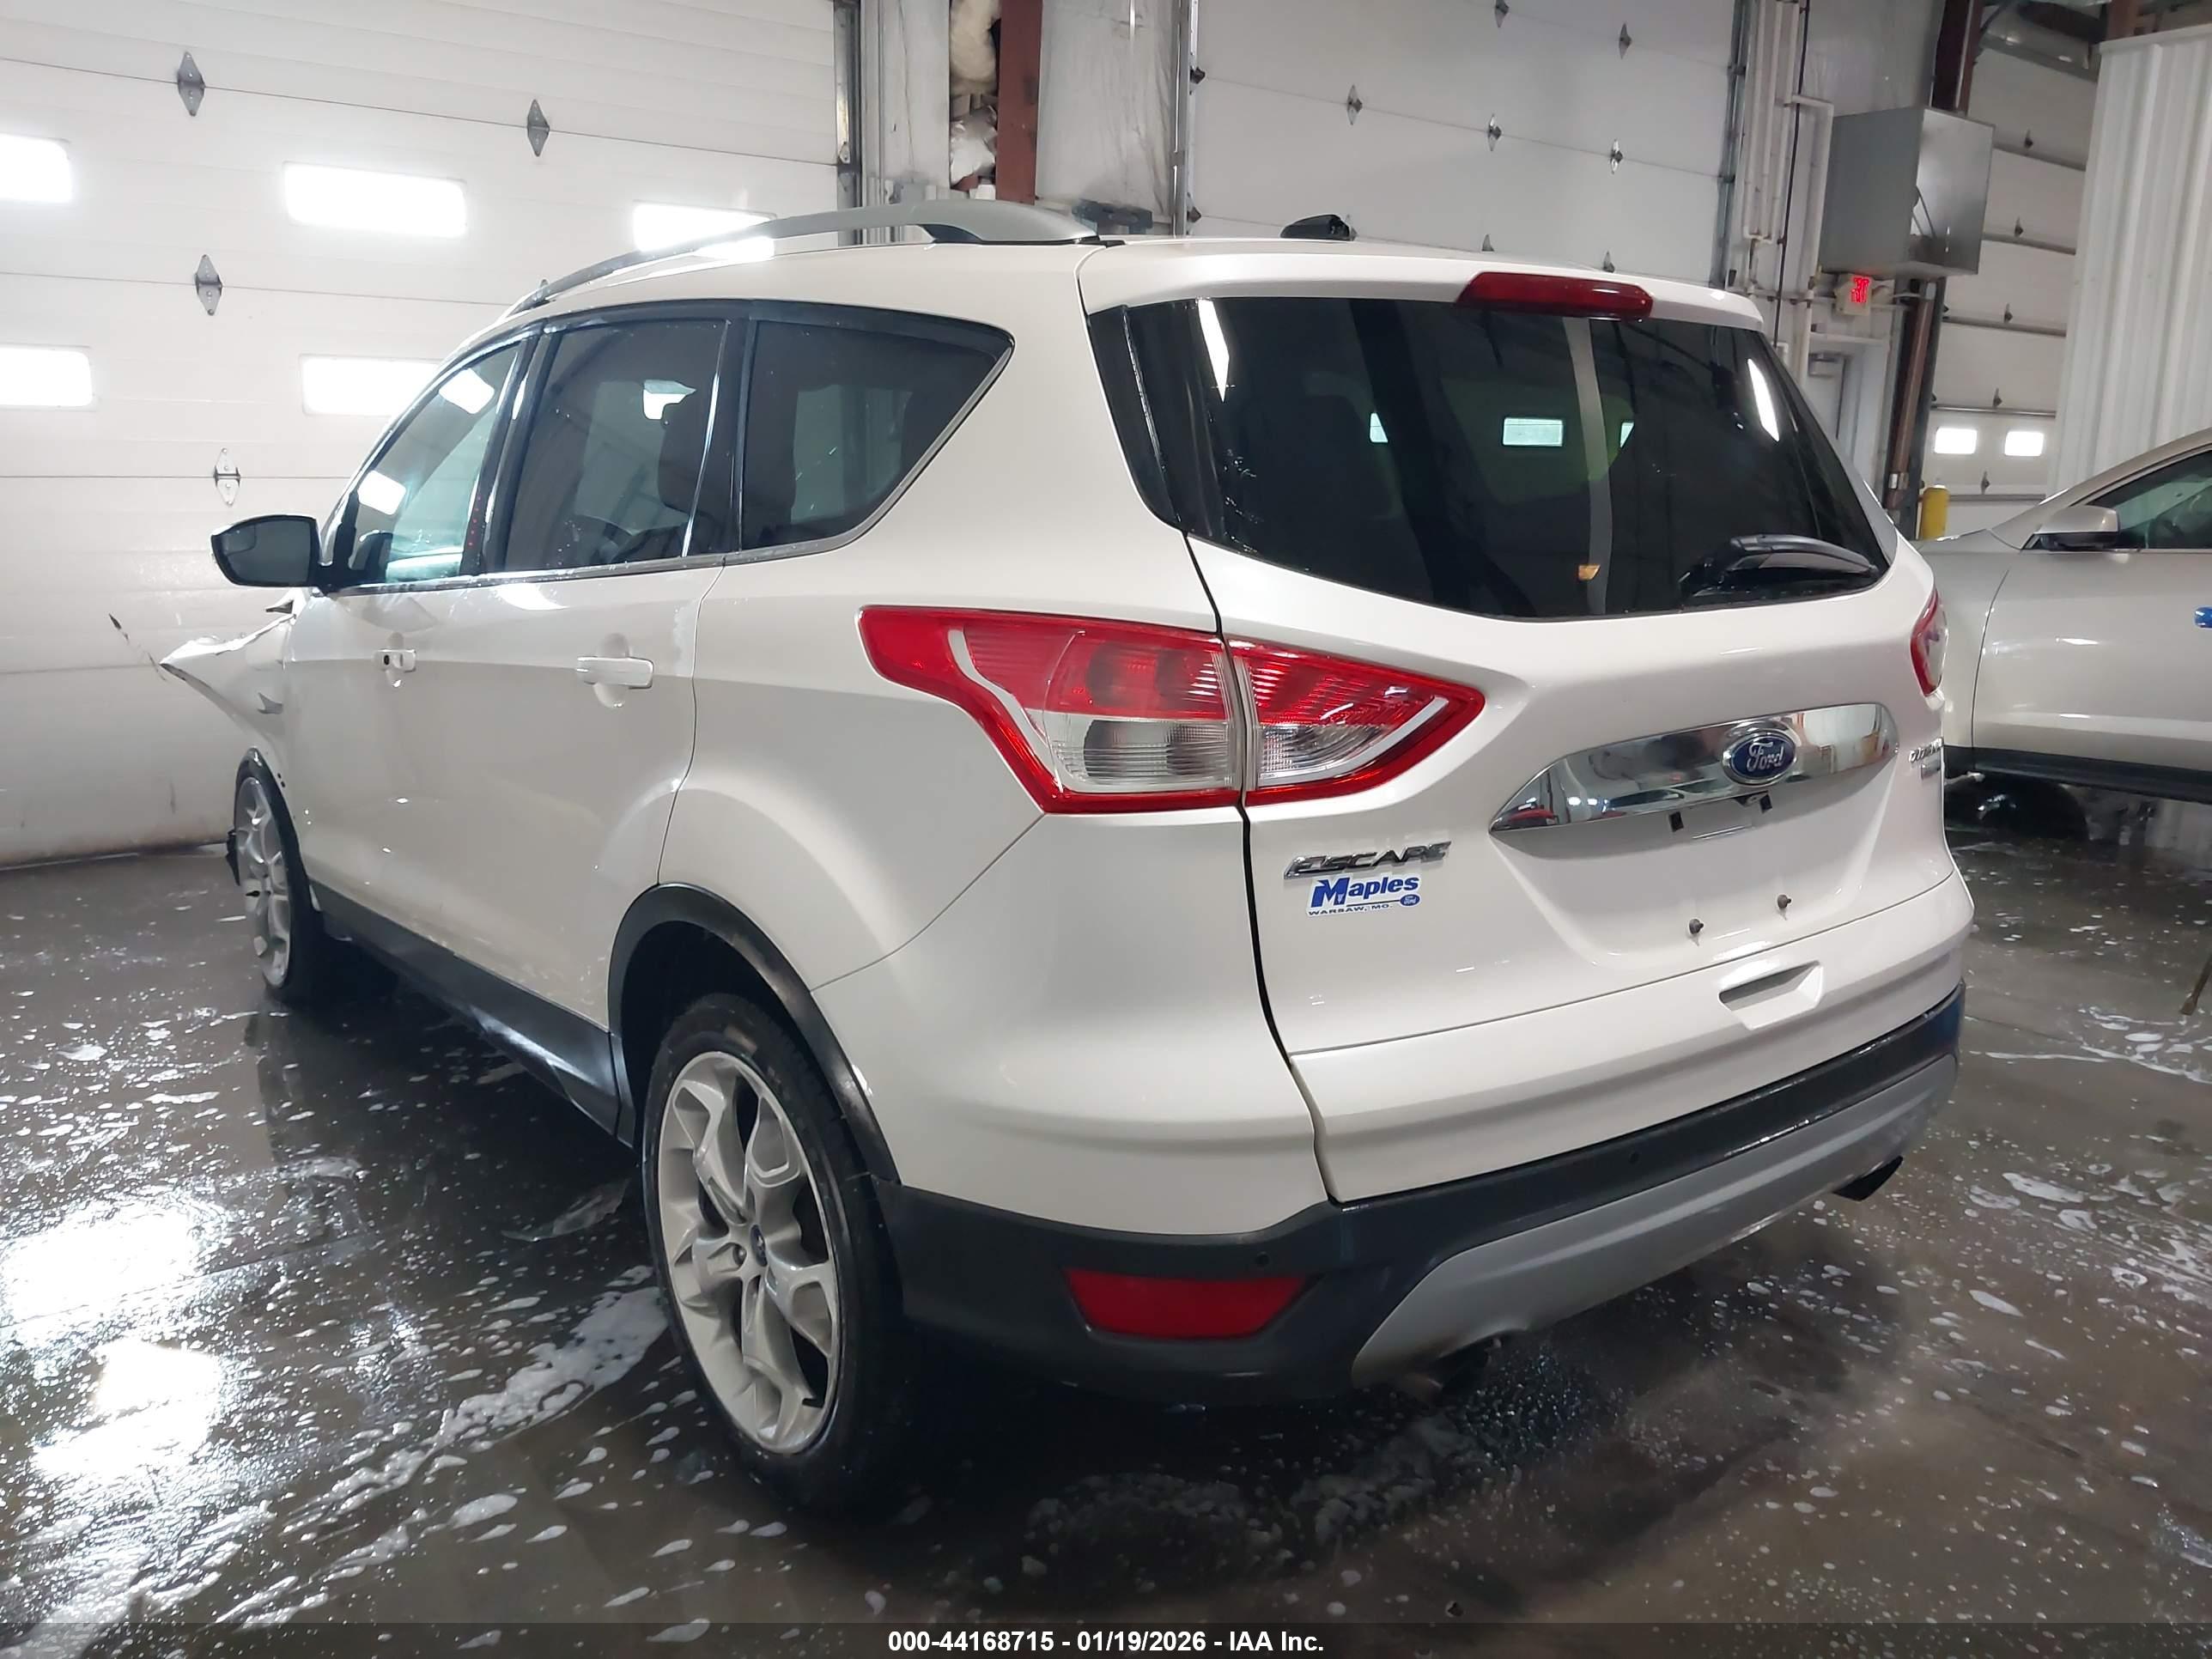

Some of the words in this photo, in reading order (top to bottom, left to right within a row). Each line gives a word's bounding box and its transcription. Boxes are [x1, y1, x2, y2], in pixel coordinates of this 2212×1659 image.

[1746, 741, 1784, 772] Ford
[1283, 841, 1452, 879] ESCAPE
[1310, 876, 1420, 908] Maples
[1308, 906, 1368, 916] WARSAW,
